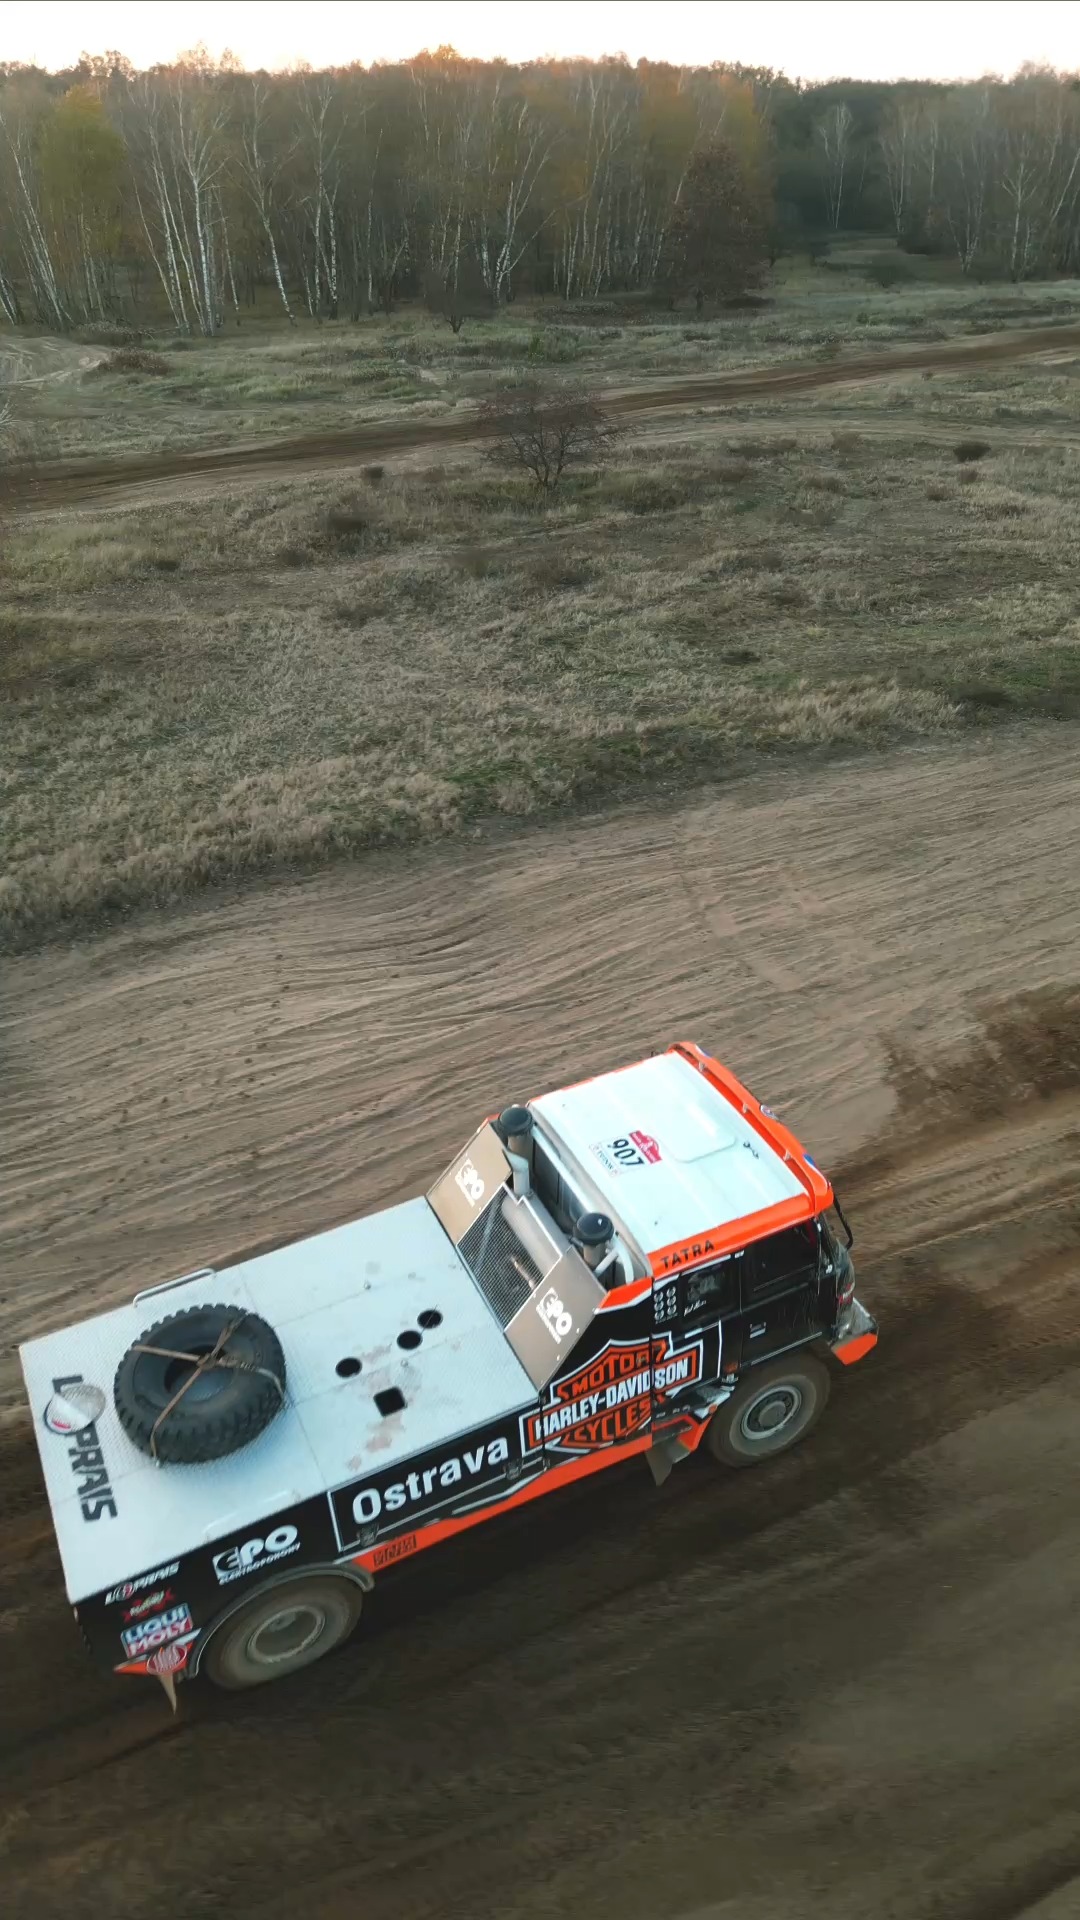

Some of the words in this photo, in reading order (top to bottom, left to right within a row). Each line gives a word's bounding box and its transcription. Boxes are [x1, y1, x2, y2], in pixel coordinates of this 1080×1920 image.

[607, 1138, 645, 1166] 907
[661, 1239, 715, 1269] TATRA
[538, 1287, 573, 1336] EPO
[571, 1348, 652, 1399] MOTOR
[534, 1357, 690, 1442] HARLEY-DAVIDSON
[573, 1400, 652, 1442] CYCLES
[352, 1436, 509, 1525] Ostrava
[212, 1524, 299, 1580] EPO
[123, 1605, 188, 1643] LIQUI
[127, 1617, 190, 1657] MOLY
